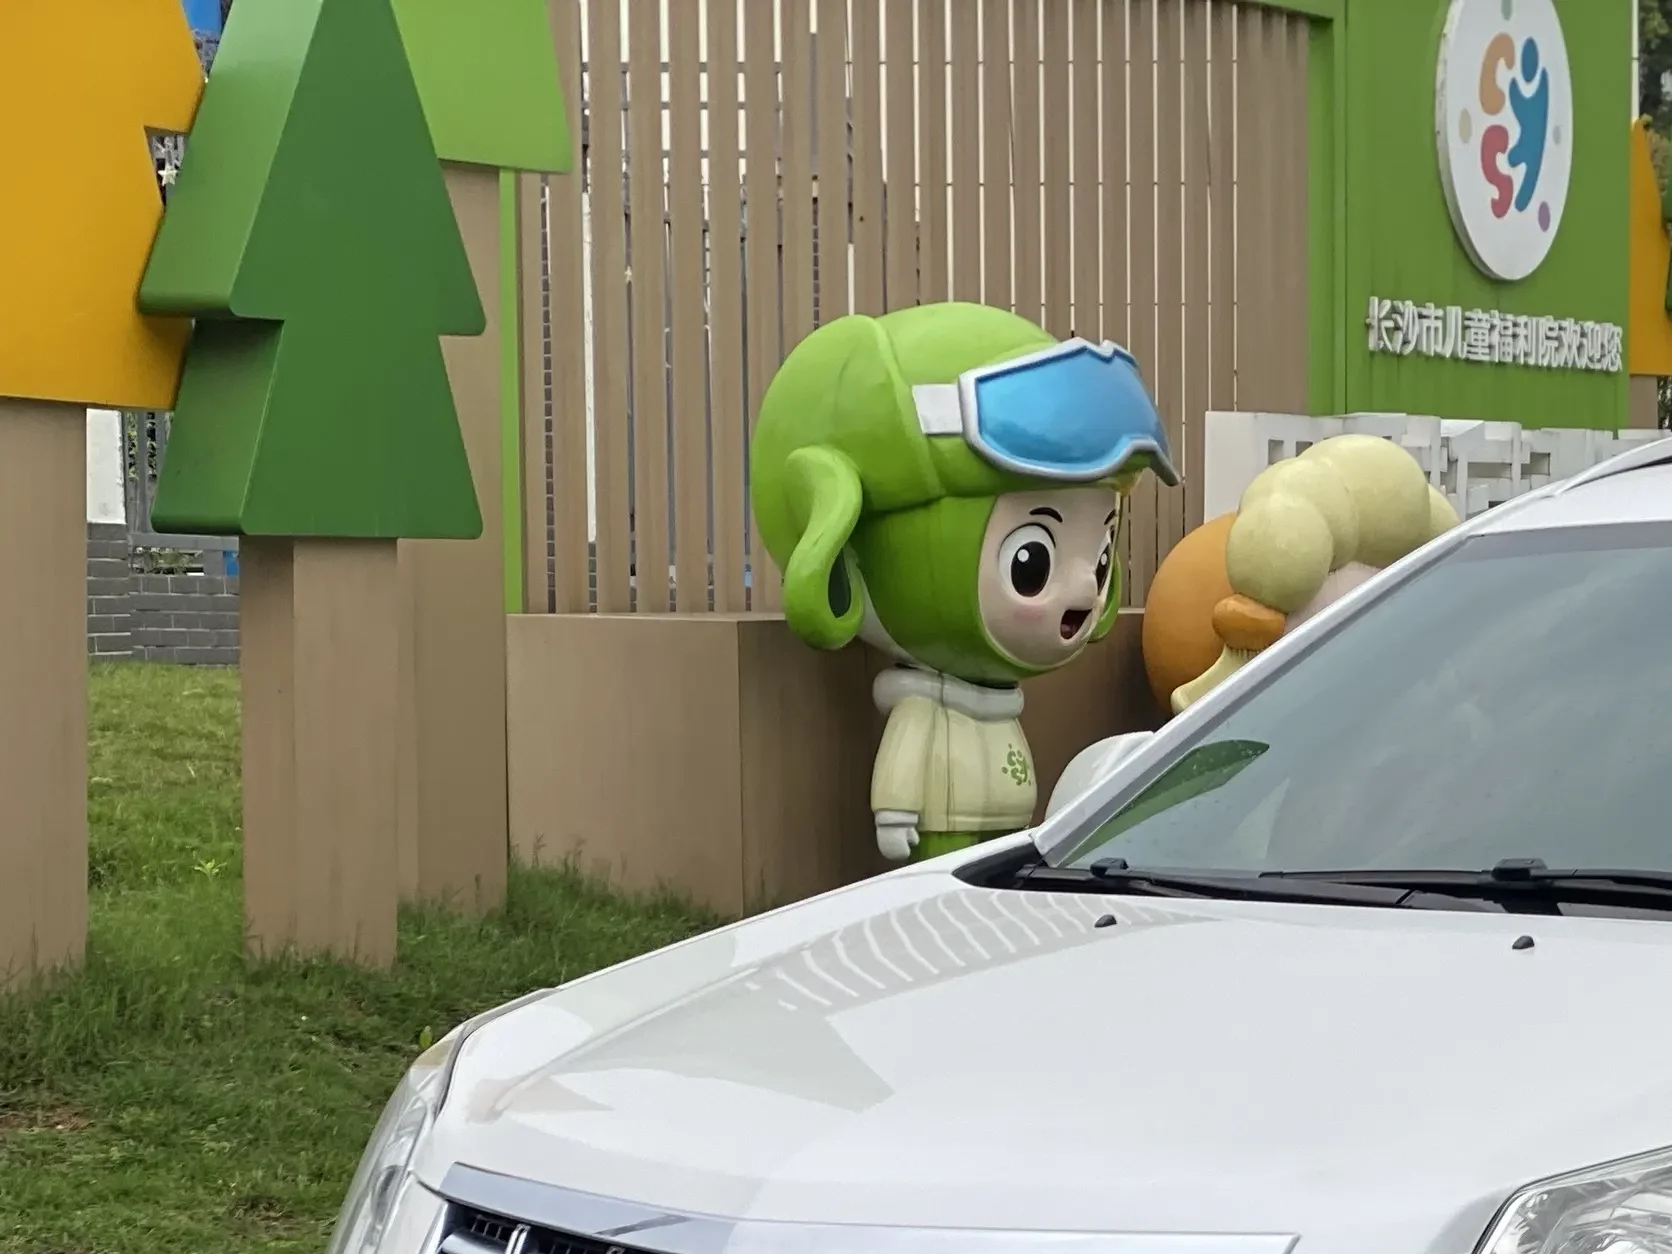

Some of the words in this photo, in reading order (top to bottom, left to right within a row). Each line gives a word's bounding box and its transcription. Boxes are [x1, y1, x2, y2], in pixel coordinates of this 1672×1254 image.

[1366, 296, 1623, 372] 长沙市儿童福利院欢迎您
